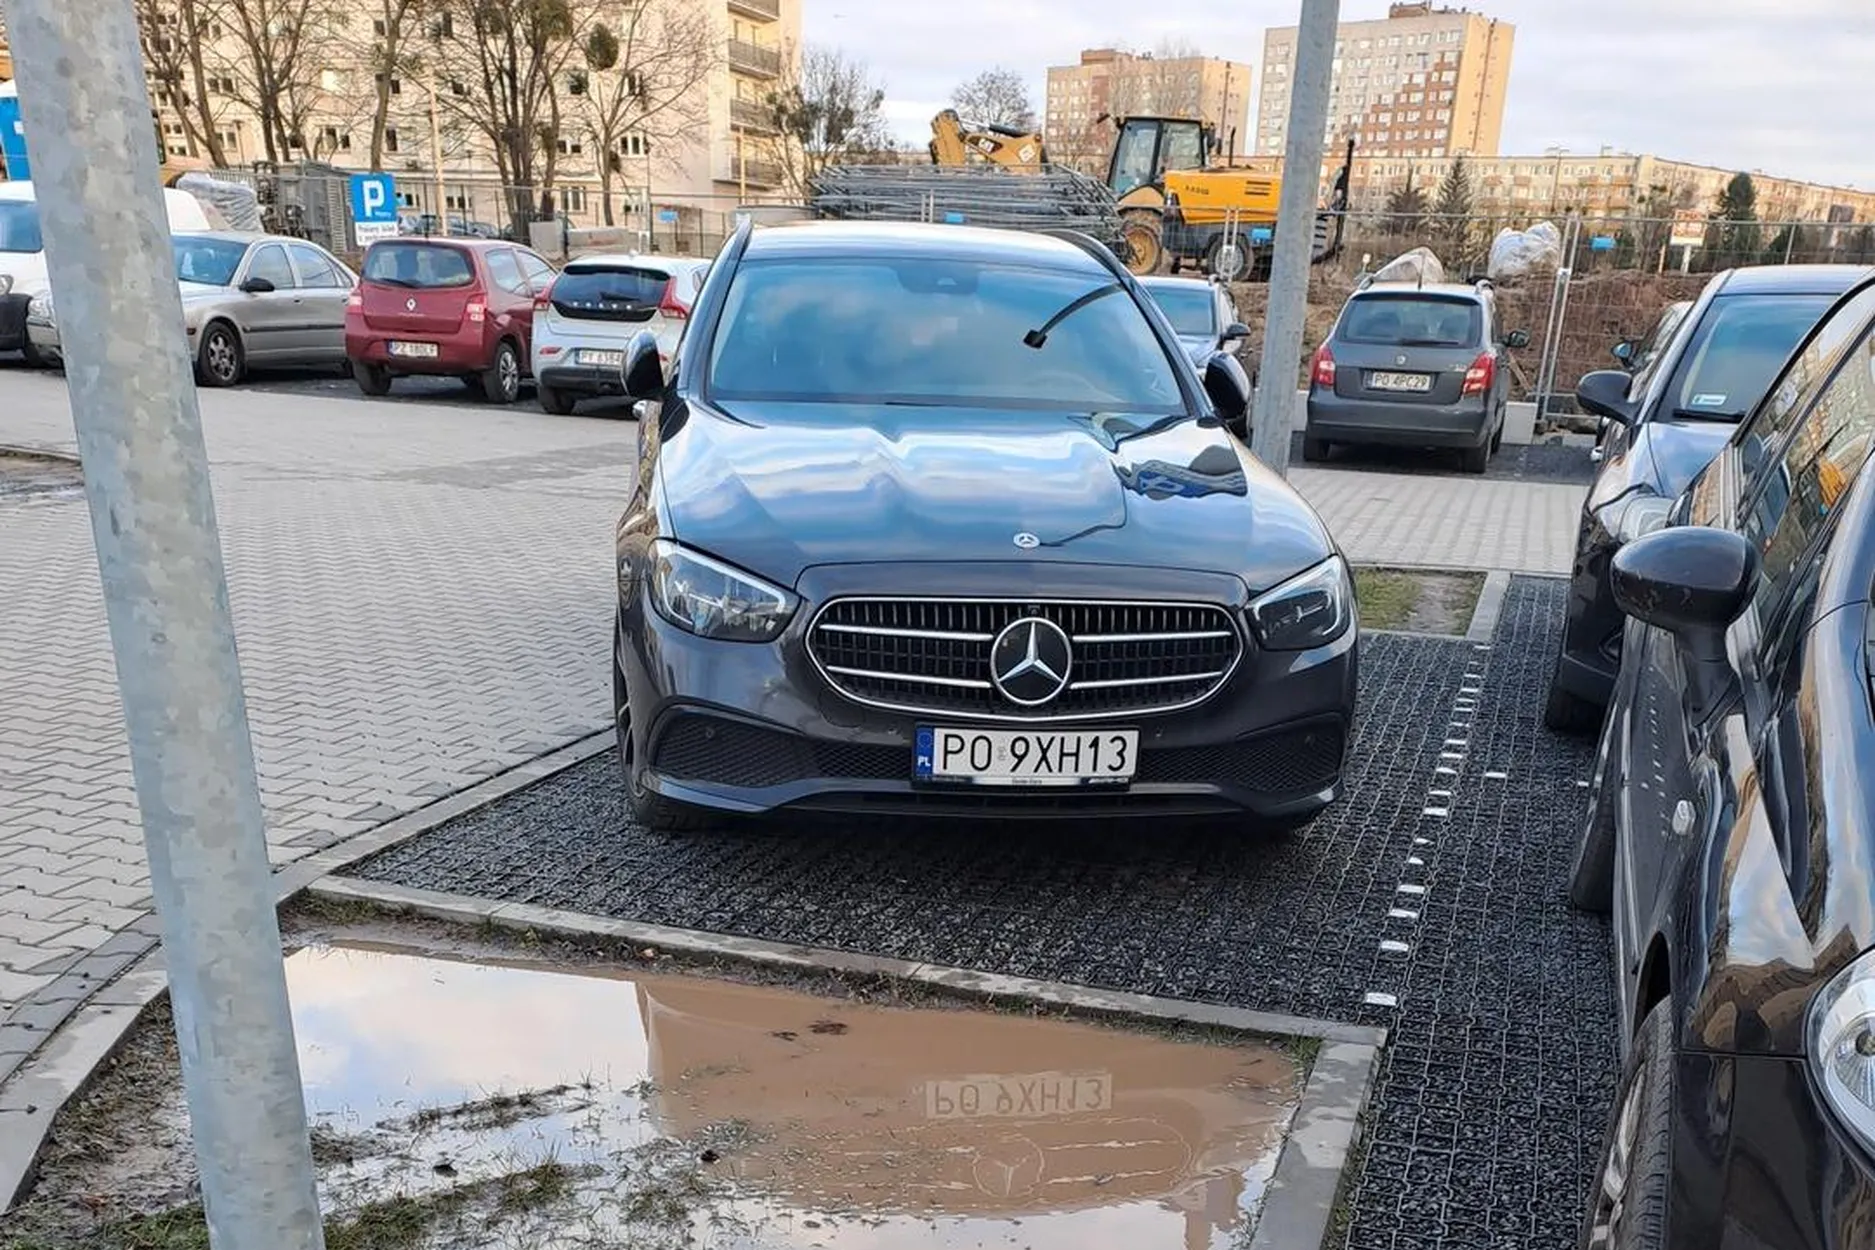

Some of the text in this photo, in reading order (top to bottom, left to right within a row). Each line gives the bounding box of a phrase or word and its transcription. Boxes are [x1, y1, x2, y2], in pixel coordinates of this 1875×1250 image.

[363, 180, 384, 217] P
[1375, 374, 1390, 386] PO
[917, 755, 931, 767] PL
[943, 733, 1127, 773] PO 9XH13
